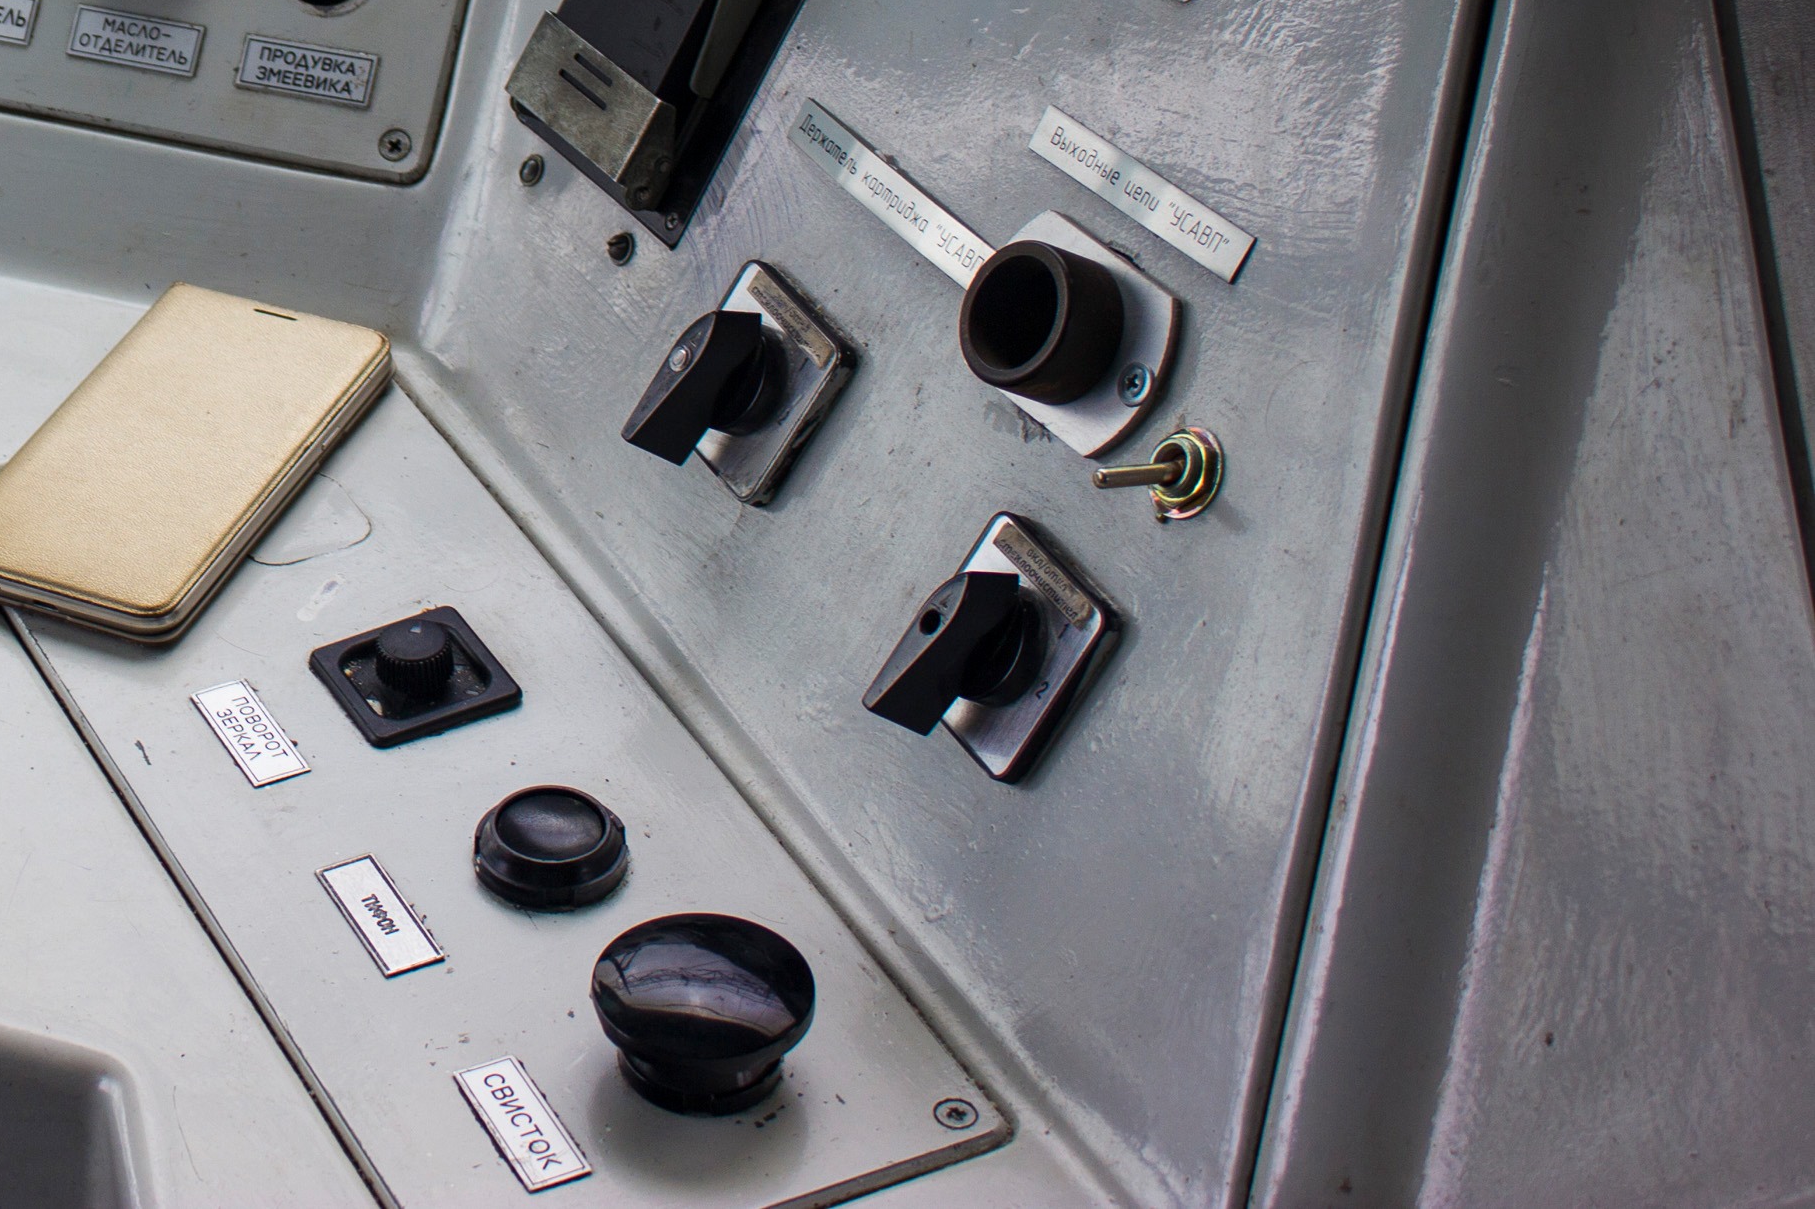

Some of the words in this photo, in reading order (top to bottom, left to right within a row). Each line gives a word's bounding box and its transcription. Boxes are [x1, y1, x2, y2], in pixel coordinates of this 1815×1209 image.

[78, 33, 189, 66] ОТДЕЛИТЕЛЬ
[102, 17, 171, 41] МАСЛО-
[254, 65, 354, 97] ЗМЕЕВИКА
[258, 45, 357, 77] ПРОДУВКА
[797, 112, 859, 178] Держатель
[860, 170, 929, 236] картриджа
[1049, 125, 1122, 188] Выходные
[1122, 178, 1162, 213] цепи
[1034, 680, 1049, 700] 2
[216, 707, 262, 762] ЗЕРКАЛ
[231, 695, 289, 759] ПОВОРОТ
[360, 892, 400, 936] ТИФОН
[482, 1072, 563, 1171] СВИСТОК
